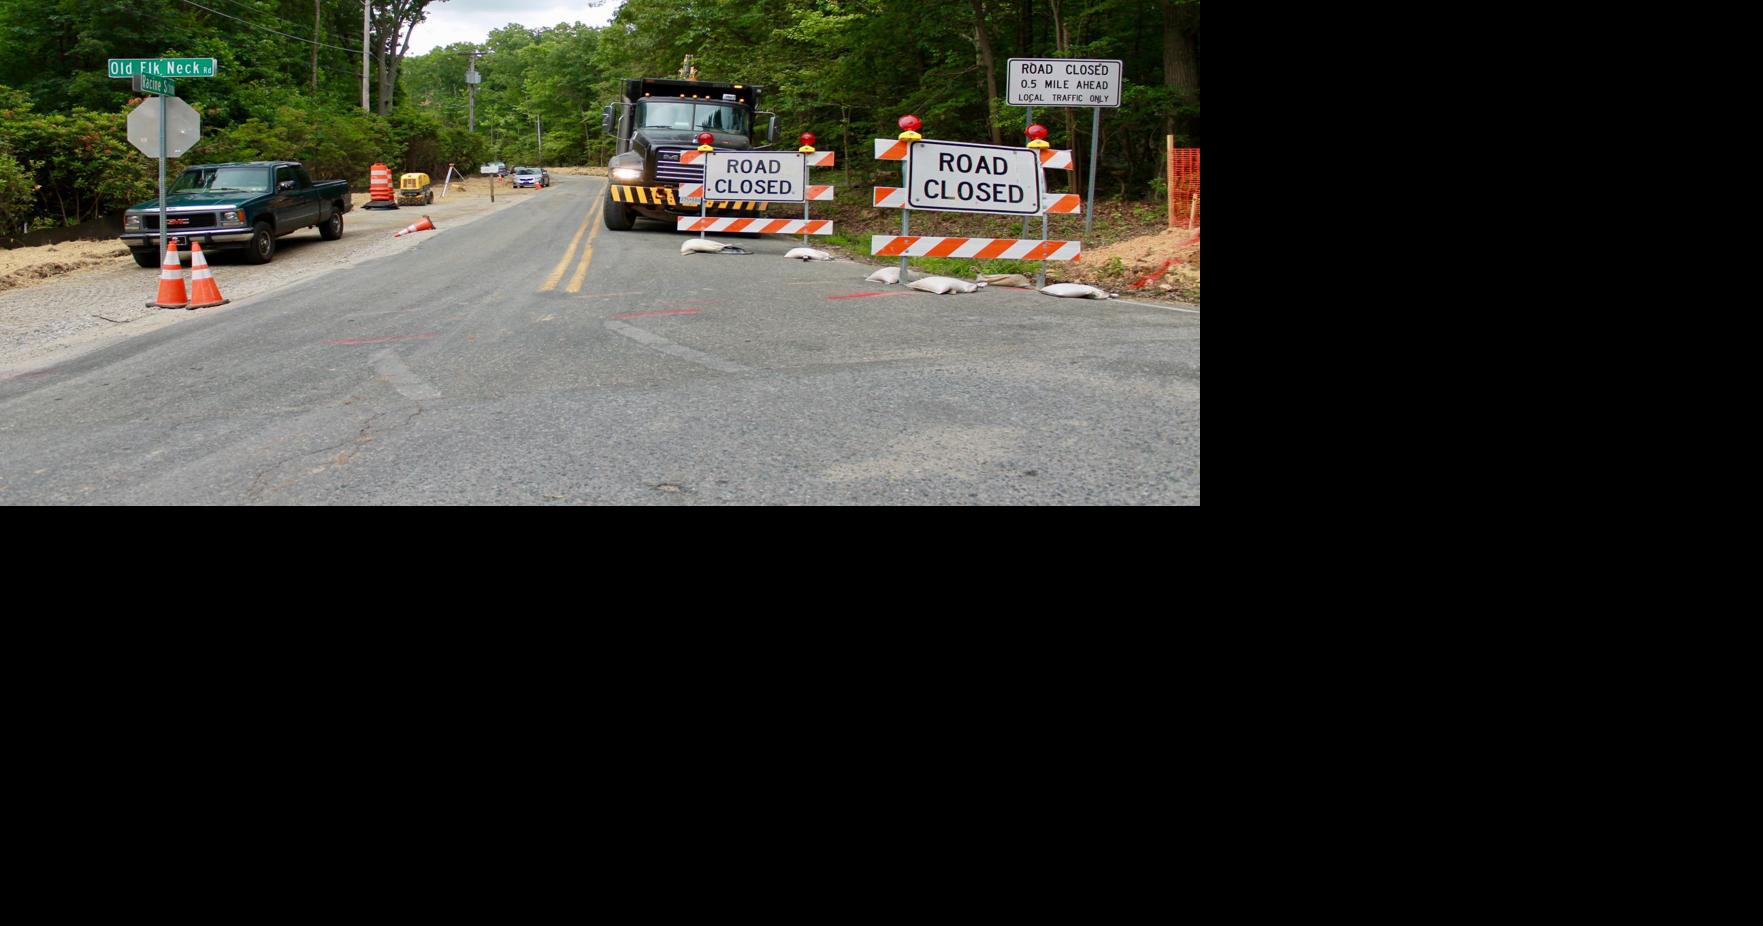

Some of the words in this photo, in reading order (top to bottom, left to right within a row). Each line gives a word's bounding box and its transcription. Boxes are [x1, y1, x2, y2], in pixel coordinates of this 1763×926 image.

[110, 61, 132, 75] Old
[167, 61, 200, 74] Neck
[203, 66, 212, 74] Rd
[1021, 63, 1053, 75] ROAD
[1065, 64, 1109, 76] CLOSED
[142, 74, 161, 92] Racine
[1020, 79, 1037, 89] 0.5
[1044, 80, 1069, 89] MILE
[1076, 80, 1109, 90] AHEAD
[1018, 93, 1044, 102] LOCAL
[1052, 94, 1083, 102] TRAFFIC
[1089, 95, 1109, 103] ONLY
[727, 159, 781, 174] ROAD
[939, 152, 1008, 176] ROAD
[714, 179, 792, 195] CLOSED
[923, 179, 1024, 203] CLOSED
